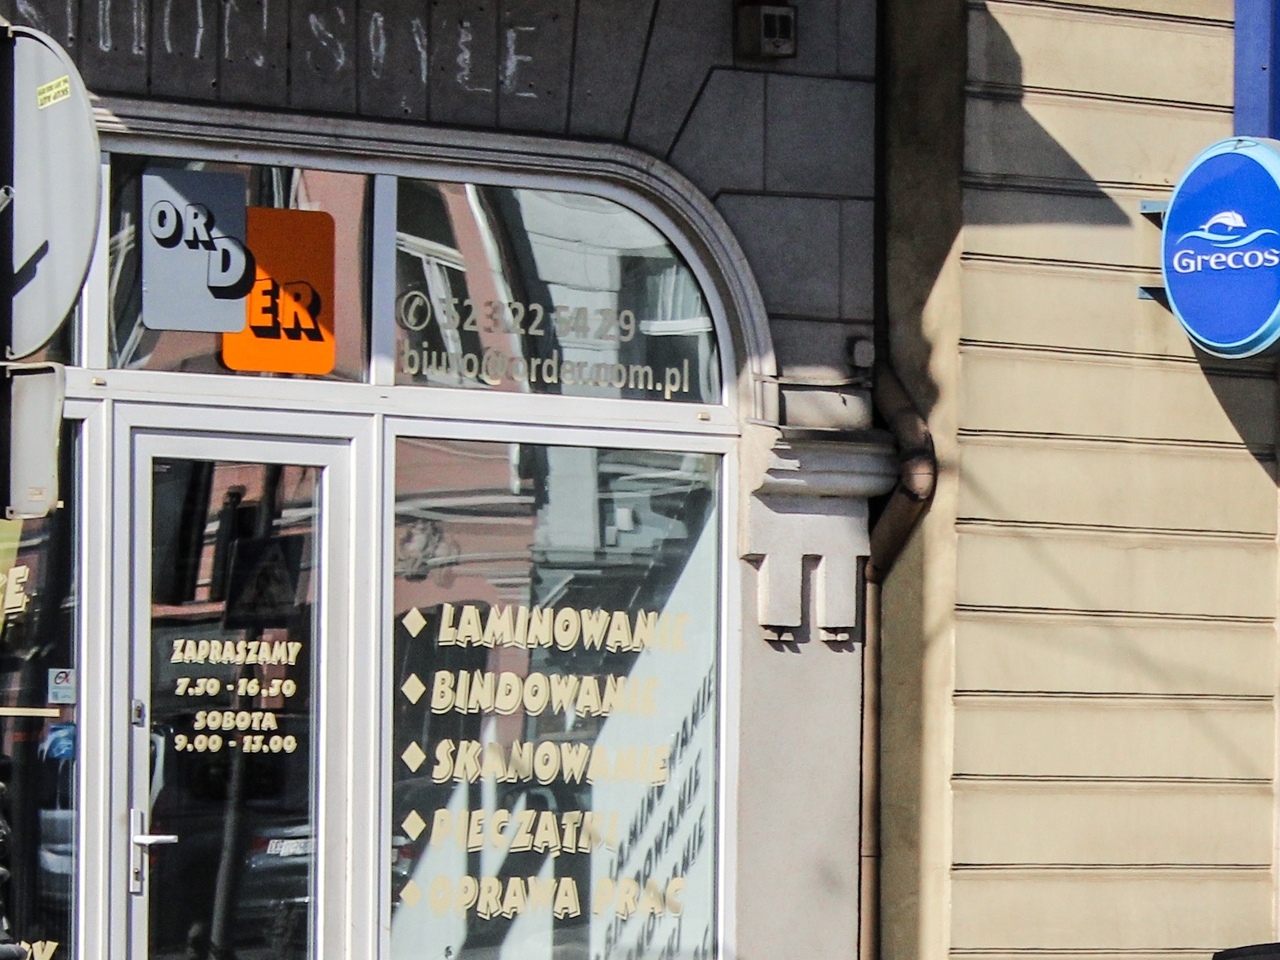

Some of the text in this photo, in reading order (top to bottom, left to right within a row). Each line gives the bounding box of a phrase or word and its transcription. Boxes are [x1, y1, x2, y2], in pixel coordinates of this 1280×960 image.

[1173, 248, 1280, 274] Grecos
[402, 339, 690, 400] biuro@order.com.pl
[438, 602, 690, 653] LAMINOWANIE
[170, 638, 302, 666] ZAPRASZAMY
[174, 677, 221, 697] 7.30
[237, 677, 297, 698] 16.30
[430, 668, 658, 718] BINDOWANIE
[174, 734, 223, 753] 9.00
[193, 710, 278, 731] SOBOTA
[431, 738, 671, 788] SKANOWANIE
[429, 807, 619, 858] PIECZĄTKI
[428, 873, 687, 920] OPRAWA PRAC
